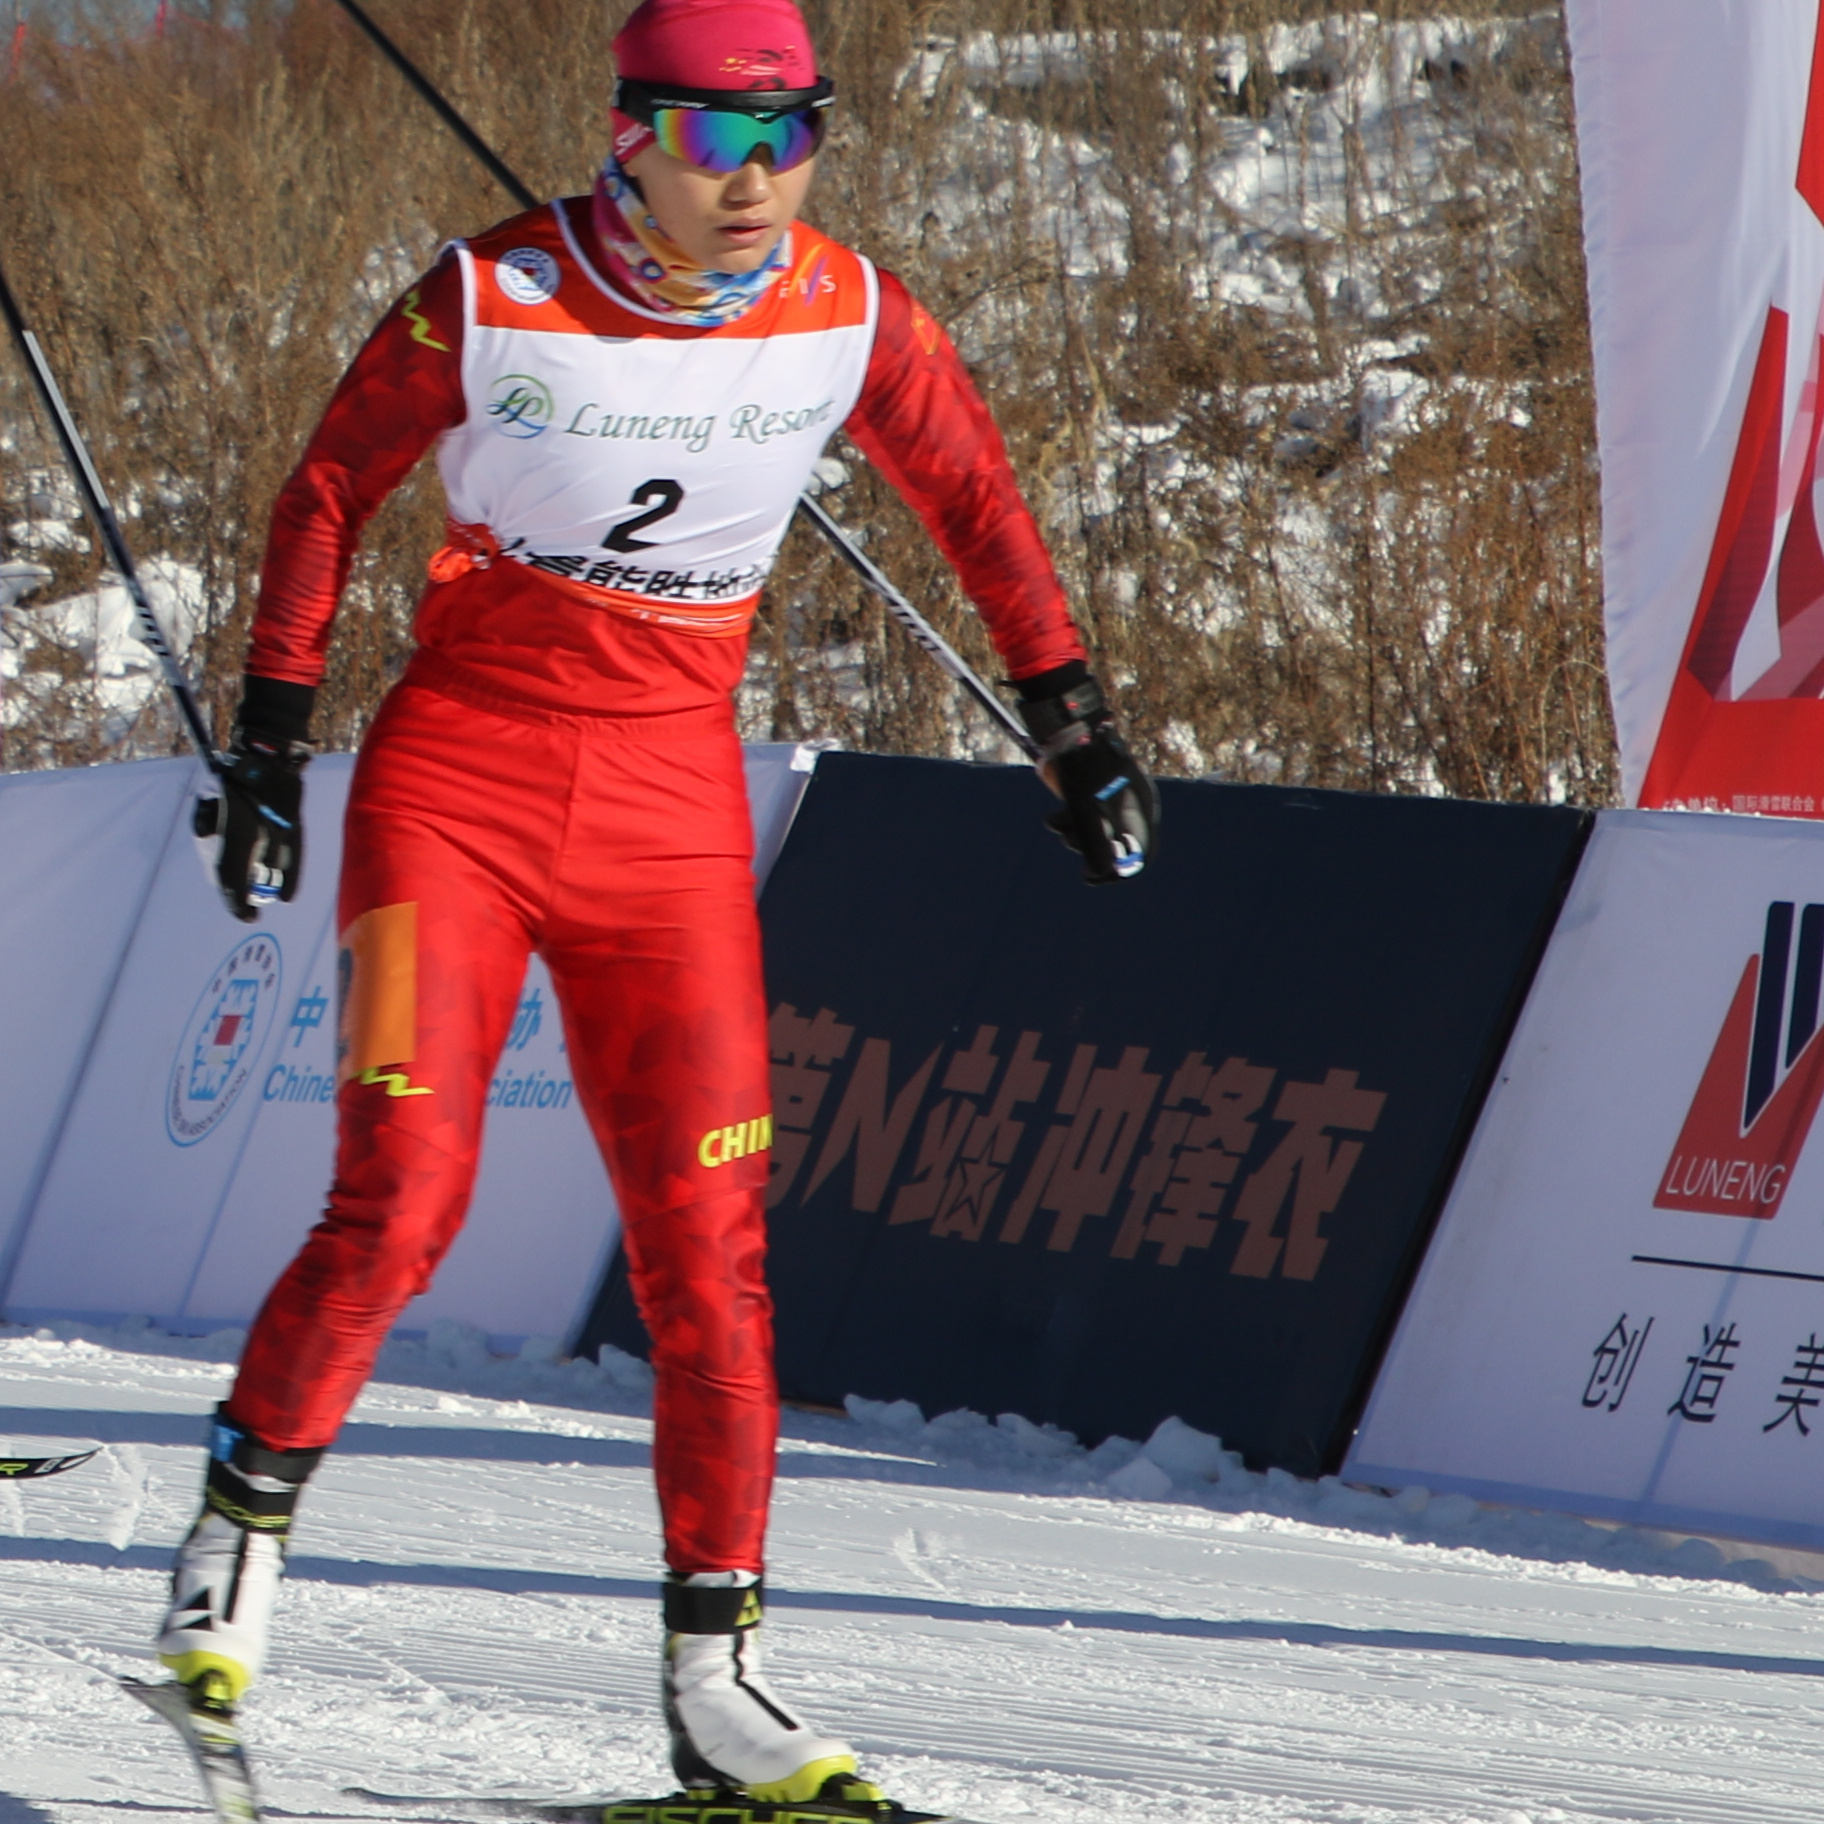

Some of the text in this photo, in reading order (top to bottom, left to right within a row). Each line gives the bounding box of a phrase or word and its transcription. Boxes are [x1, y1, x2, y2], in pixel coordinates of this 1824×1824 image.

[563, 402, 719, 454] Luneng
[601, 479, 685, 554] 2
[290, 986, 330, 1048] 中
[1665, 1154, 1786, 1204] LUNENG
[1581, 1312, 1824, 1437] 创造美
